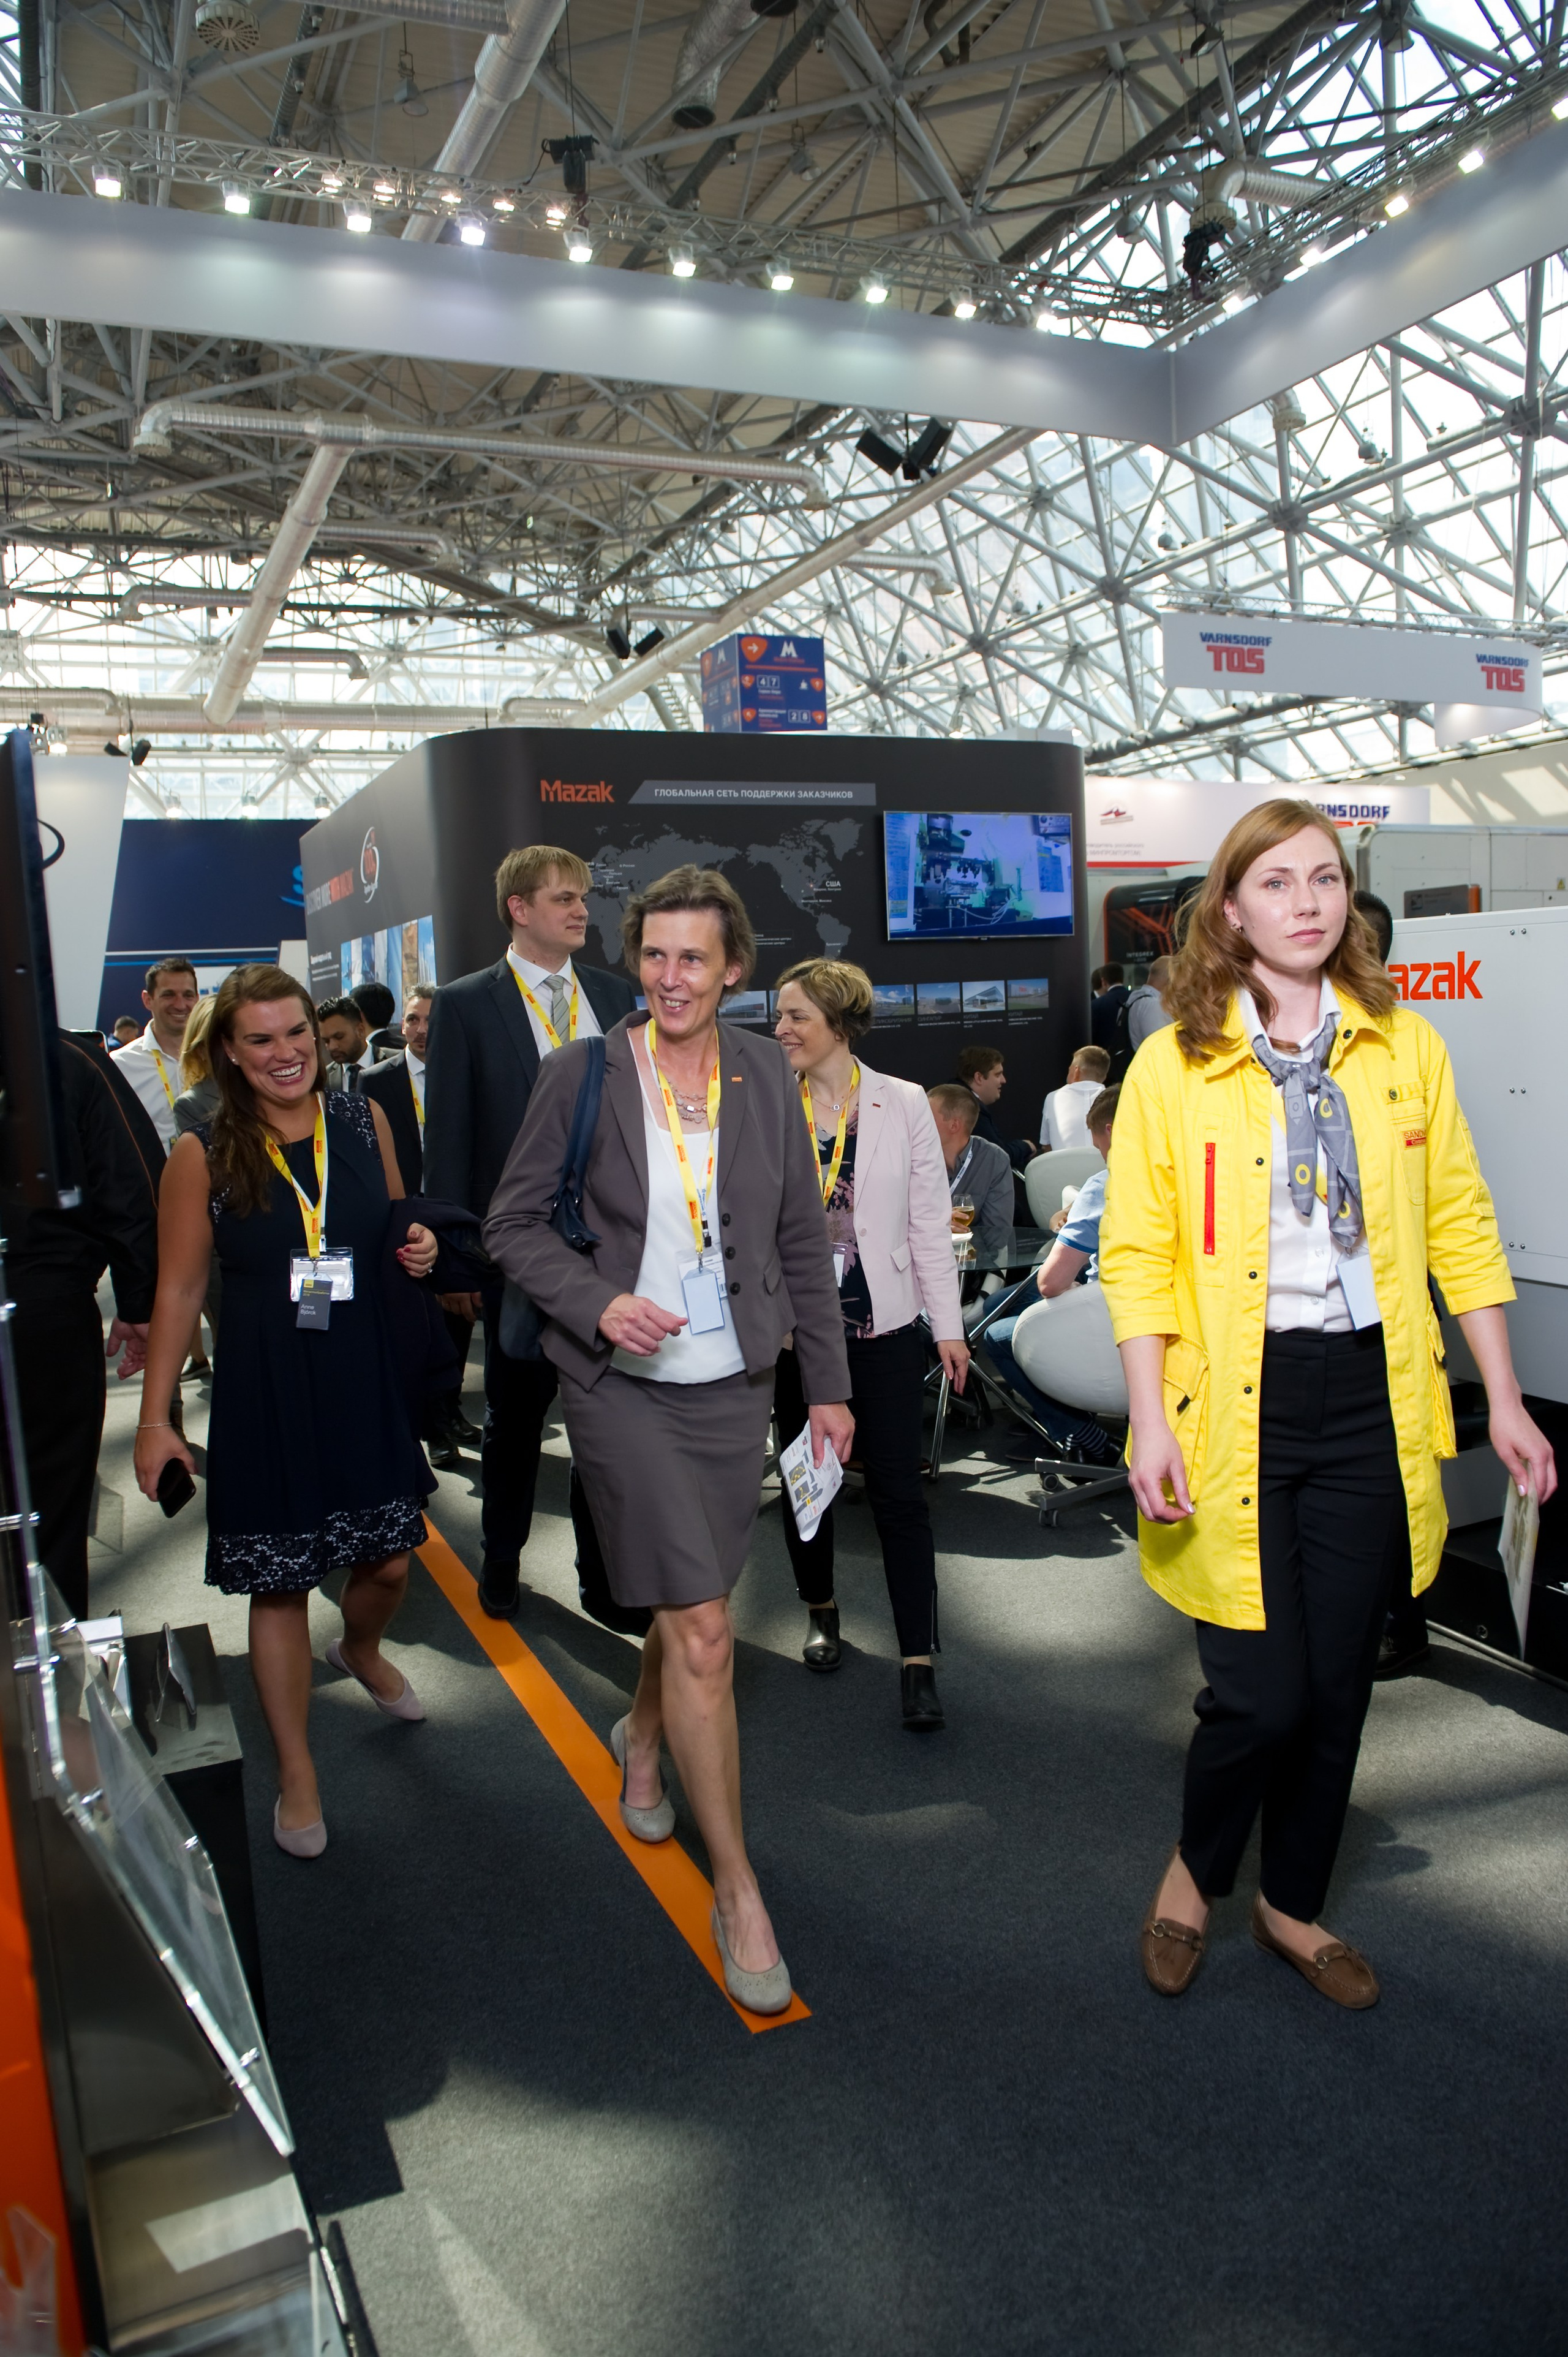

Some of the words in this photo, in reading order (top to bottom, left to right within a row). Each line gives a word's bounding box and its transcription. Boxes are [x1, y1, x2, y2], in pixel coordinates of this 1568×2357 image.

[1200, 632, 1272, 646] VARNSDORF
[1206, 645, 1265, 675] TOS
[1476, 653, 1529, 668] VARNSDORF
[1481, 665, 1525, 692] TOS
[540, 779, 615, 803] Mazak
[654, 789, 714, 797] ГЛОБАЛЬНАЯ
[741, 790, 796, 799] ПОДДЕРЖКИ
[1316, 804, 1390, 820] RNSDORF
[1387, 951, 1483, 1001] azak
[1403, 1129, 1427, 1140] SANDV
